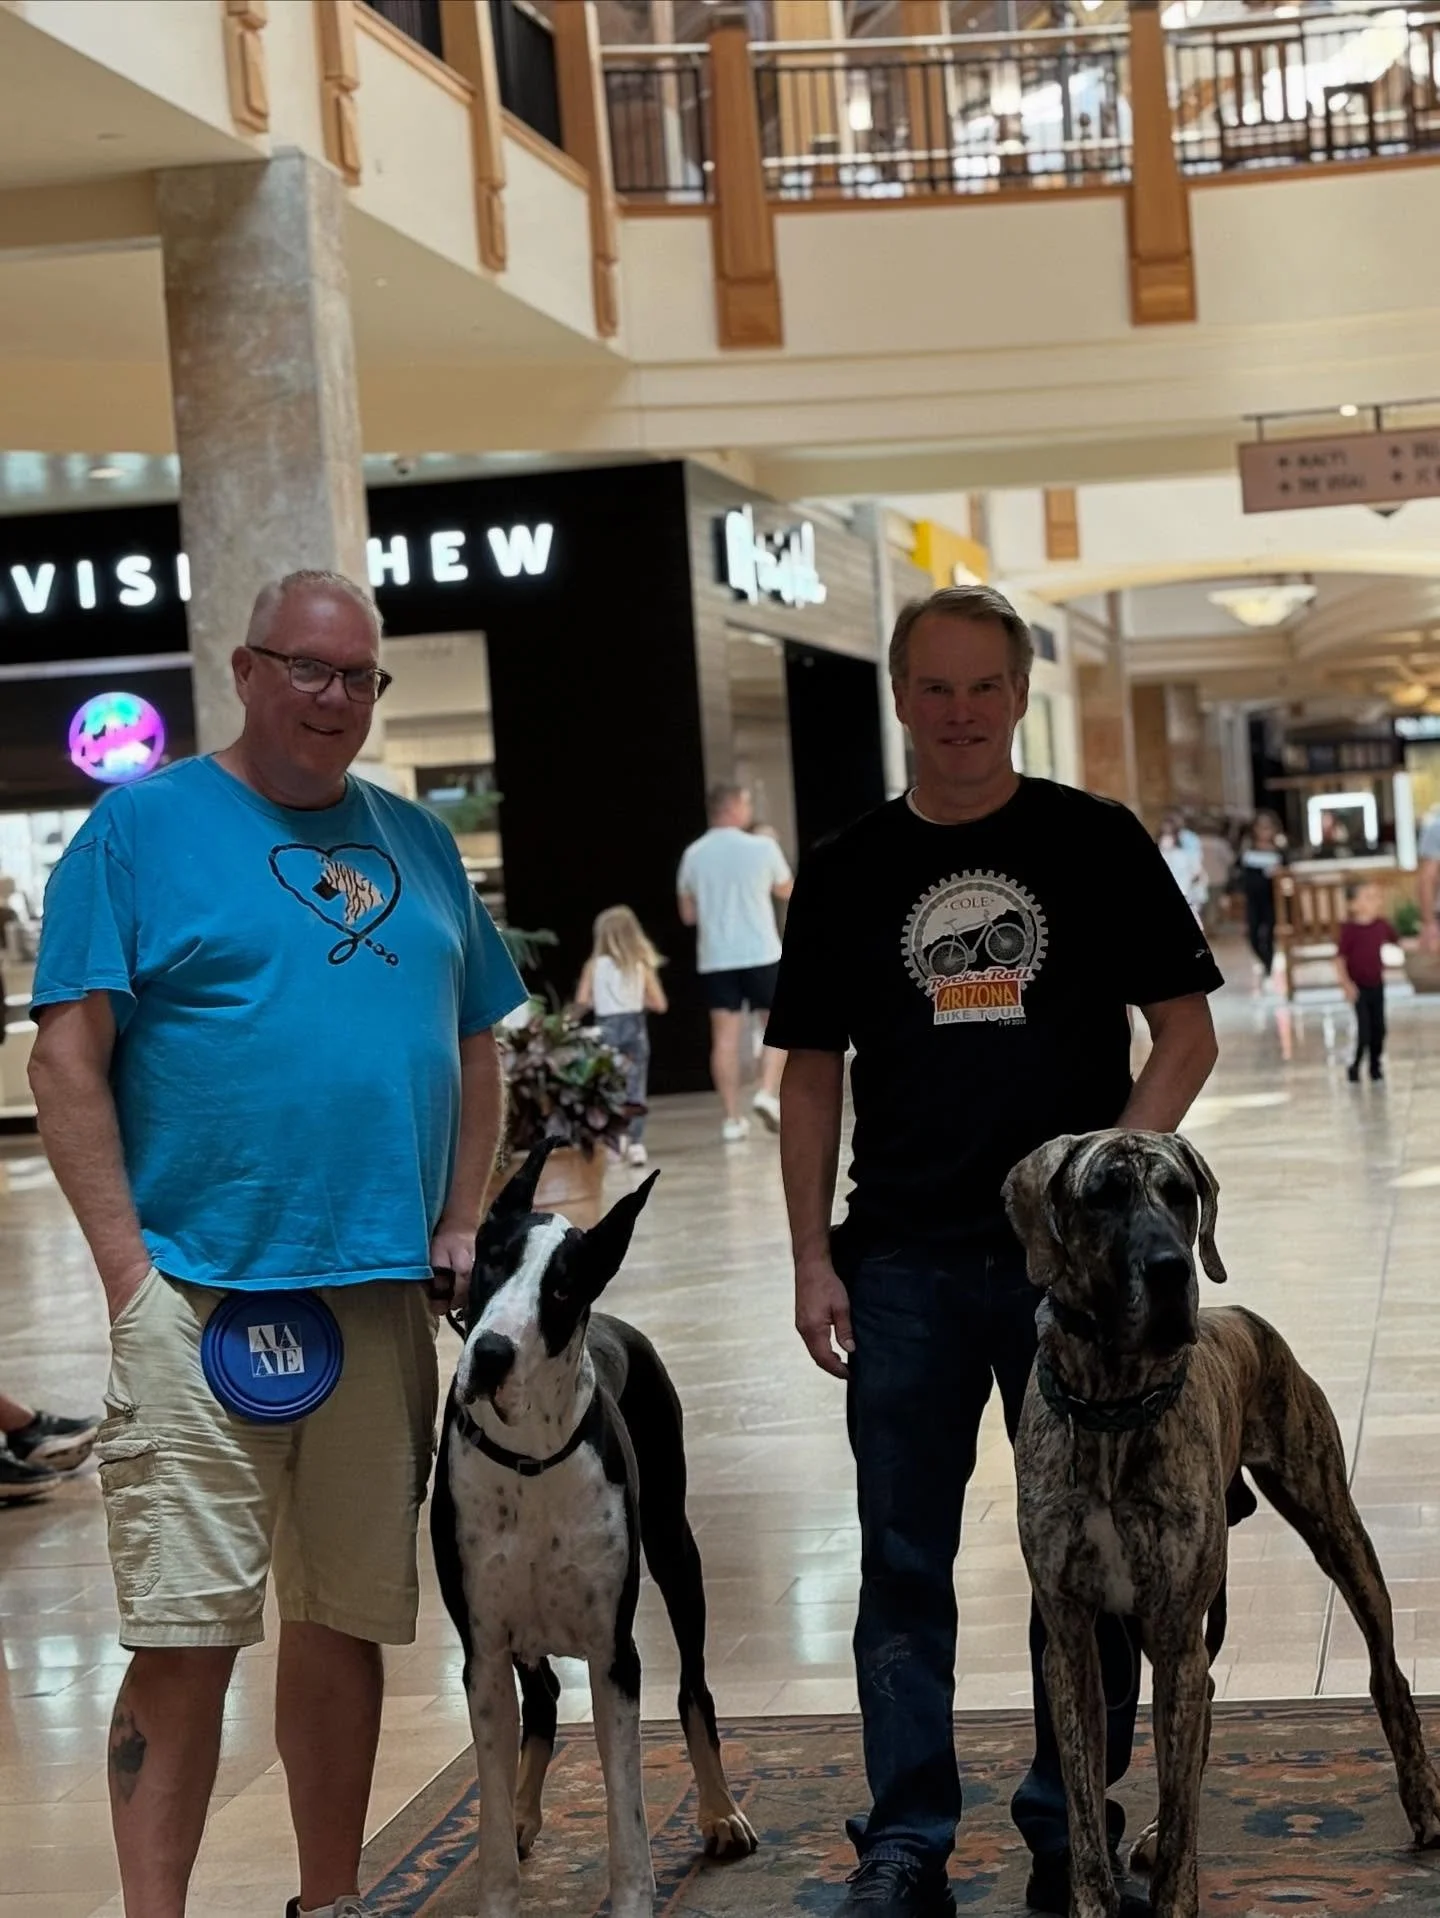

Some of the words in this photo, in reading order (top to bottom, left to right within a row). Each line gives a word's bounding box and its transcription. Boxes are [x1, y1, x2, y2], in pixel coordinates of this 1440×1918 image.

[950, 898, 990, 911] COLE
[939, 984, 1017, 1011] ARIZONA
[936, 1010, 970, 1023] BIKE
[978, 1007, 1023, 1020] TOUR
